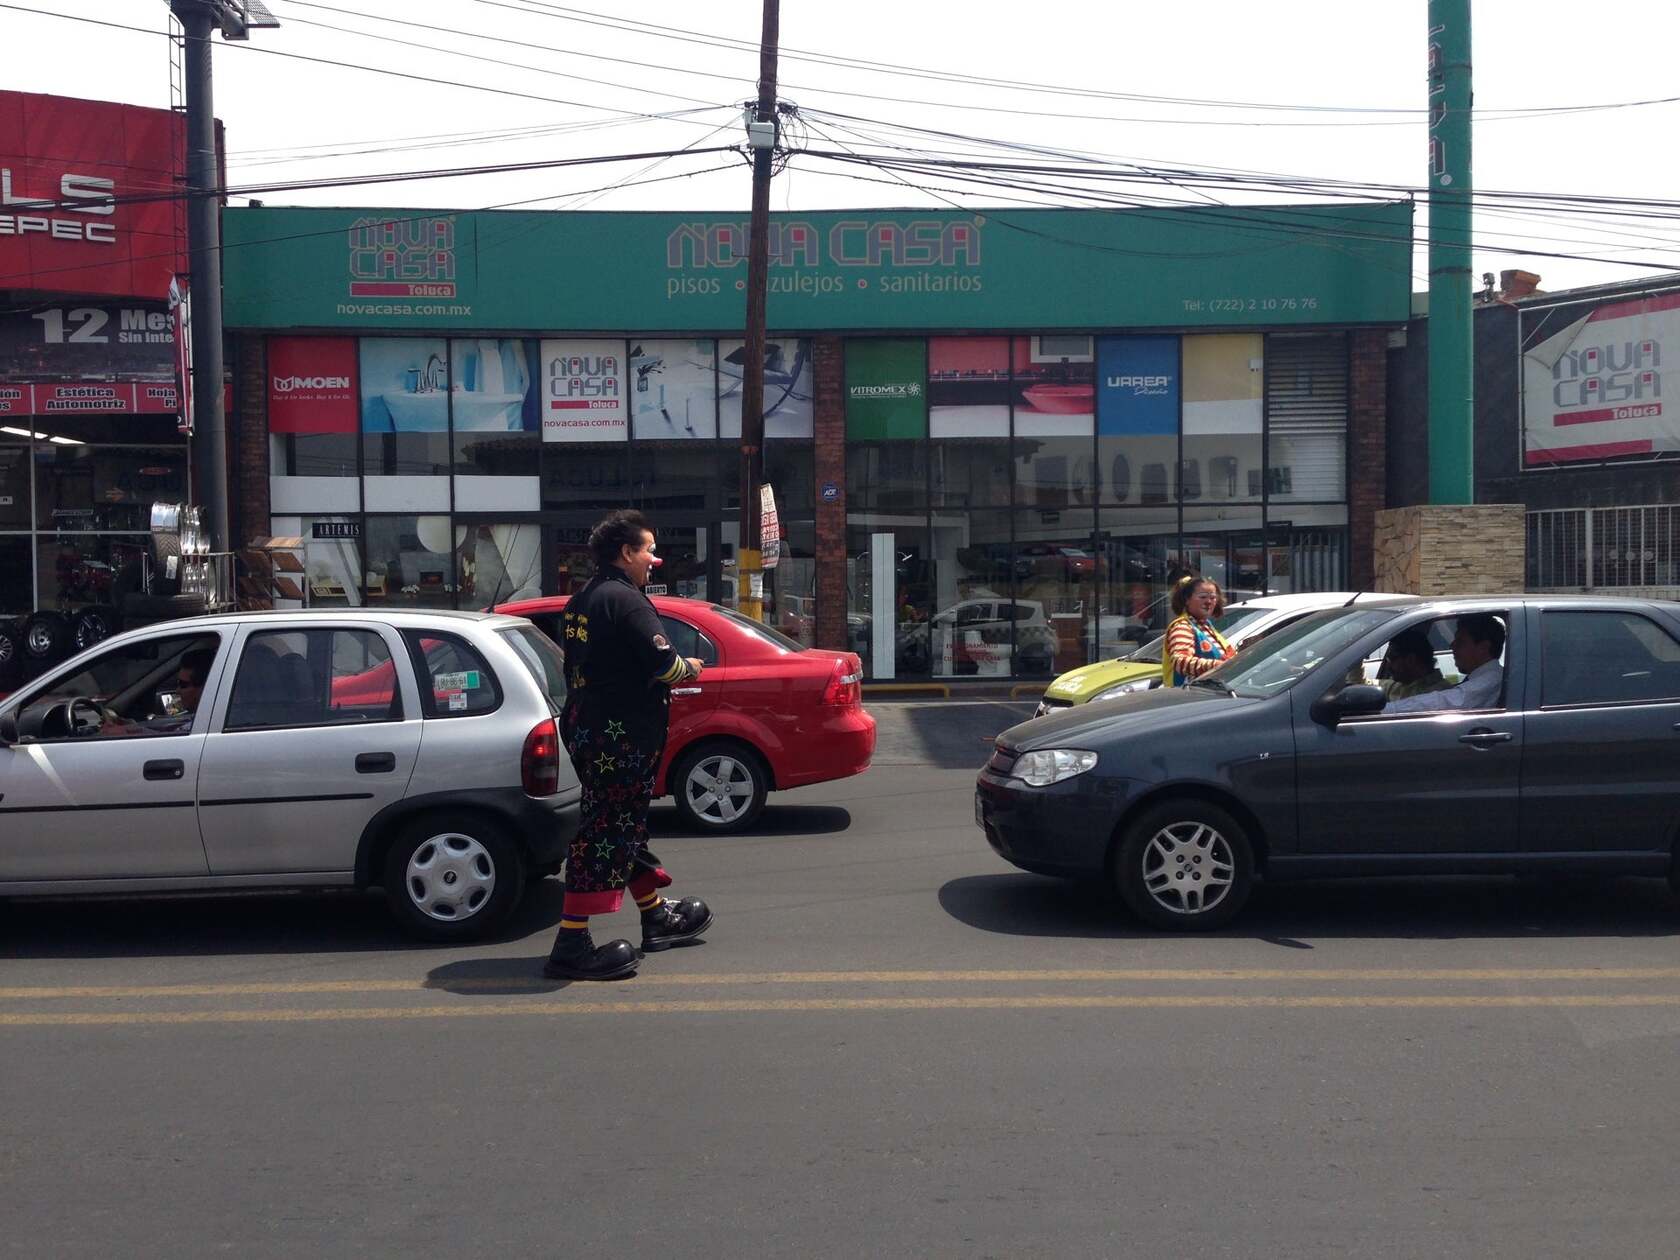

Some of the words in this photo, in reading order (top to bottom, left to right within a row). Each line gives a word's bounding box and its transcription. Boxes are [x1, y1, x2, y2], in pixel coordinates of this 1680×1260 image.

[349, 217, 454, 249] NOVA
[828, 220, 981, 267] CASA
[350, 248, 455, 279] CASA
[408, 284, 451, 296] Toluca
[667, 274, 720, 299] pisos
[767, 270, 844, 297] zulejos
[880, 272, 982, 292] sanitarios
[337, 304, 471, 315] novacasa.com.mx
[1183, 300, 1205, 311] Tel:
[1209, 299, 1245, 312] (722)
[1248, 299, 1256, 310] 2
[1263, 299, 1277, 310] 10
[1281, 299, 1297, 310] 76
[1302, 298, 1317, 309] 76
[32, 309, 109, 344] 12
[119, 331, 142, 343] Sin
[550, 356, 618, 376] NOVA
[1553, 340, 1660, 379] NOVA
[294, 377, 350, 389] MOEN
[551, 377, 618, 397] CASA
[850, 386, 906, 394] VITROMEX
[1553, 370, 1661, 407] CASA
[55, 386, 115, 398] Estética
[46, 399, 126, 410] Automotriz
[588, 401, 617, 409] Toluca
[1612, 405, 1658, 419] Toluca
